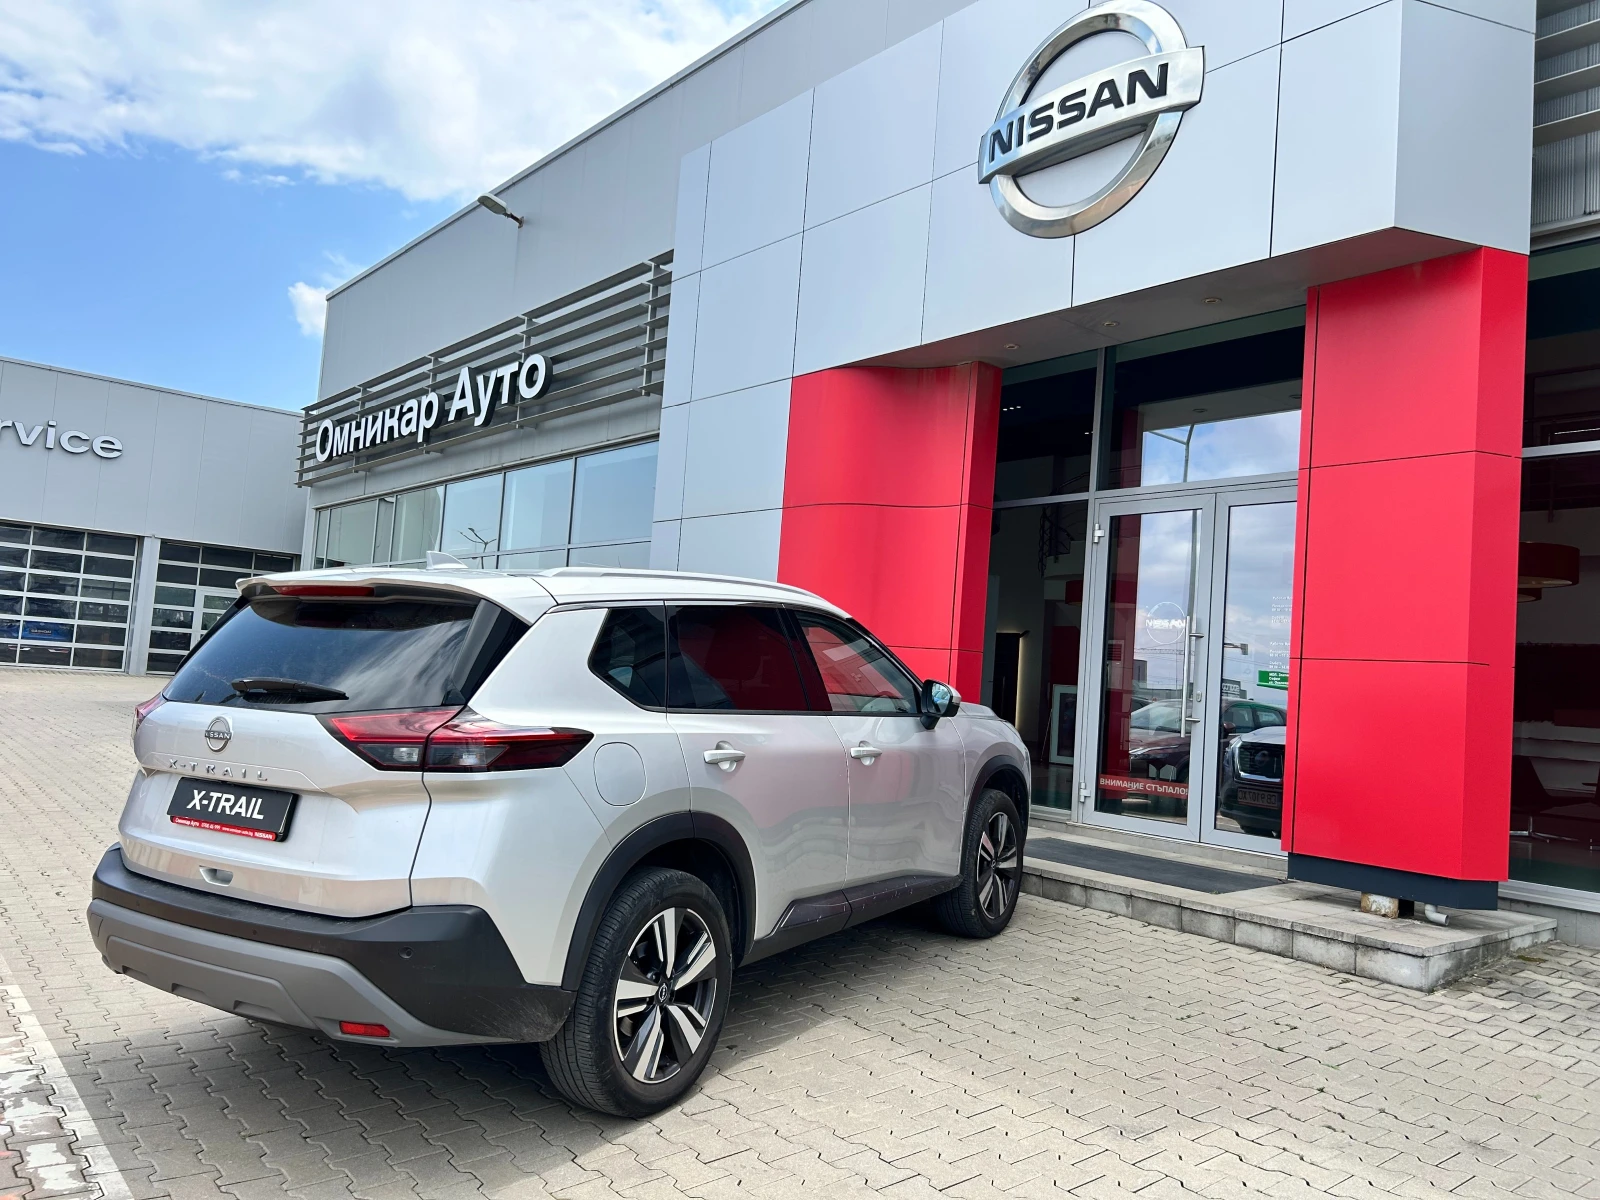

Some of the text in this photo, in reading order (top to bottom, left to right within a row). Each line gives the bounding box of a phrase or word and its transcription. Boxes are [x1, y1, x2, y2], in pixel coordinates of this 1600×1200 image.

[988, 62, 1169, 164] NISSAN
[315, 354, 546, 463] Омникар Ауто
[1145, 619, 1186, 630] NISSAN
[206, 731, 230, 739] NISSAN
[169, 759, 268, 781] X-TRAIL
[1099, 777, 1188, 795] ВНИМАНИЕ СТЪПАЛО!
[187, 789, 264, 820] X-TRAIL
[254, 831, 273, 839] NISSAN
